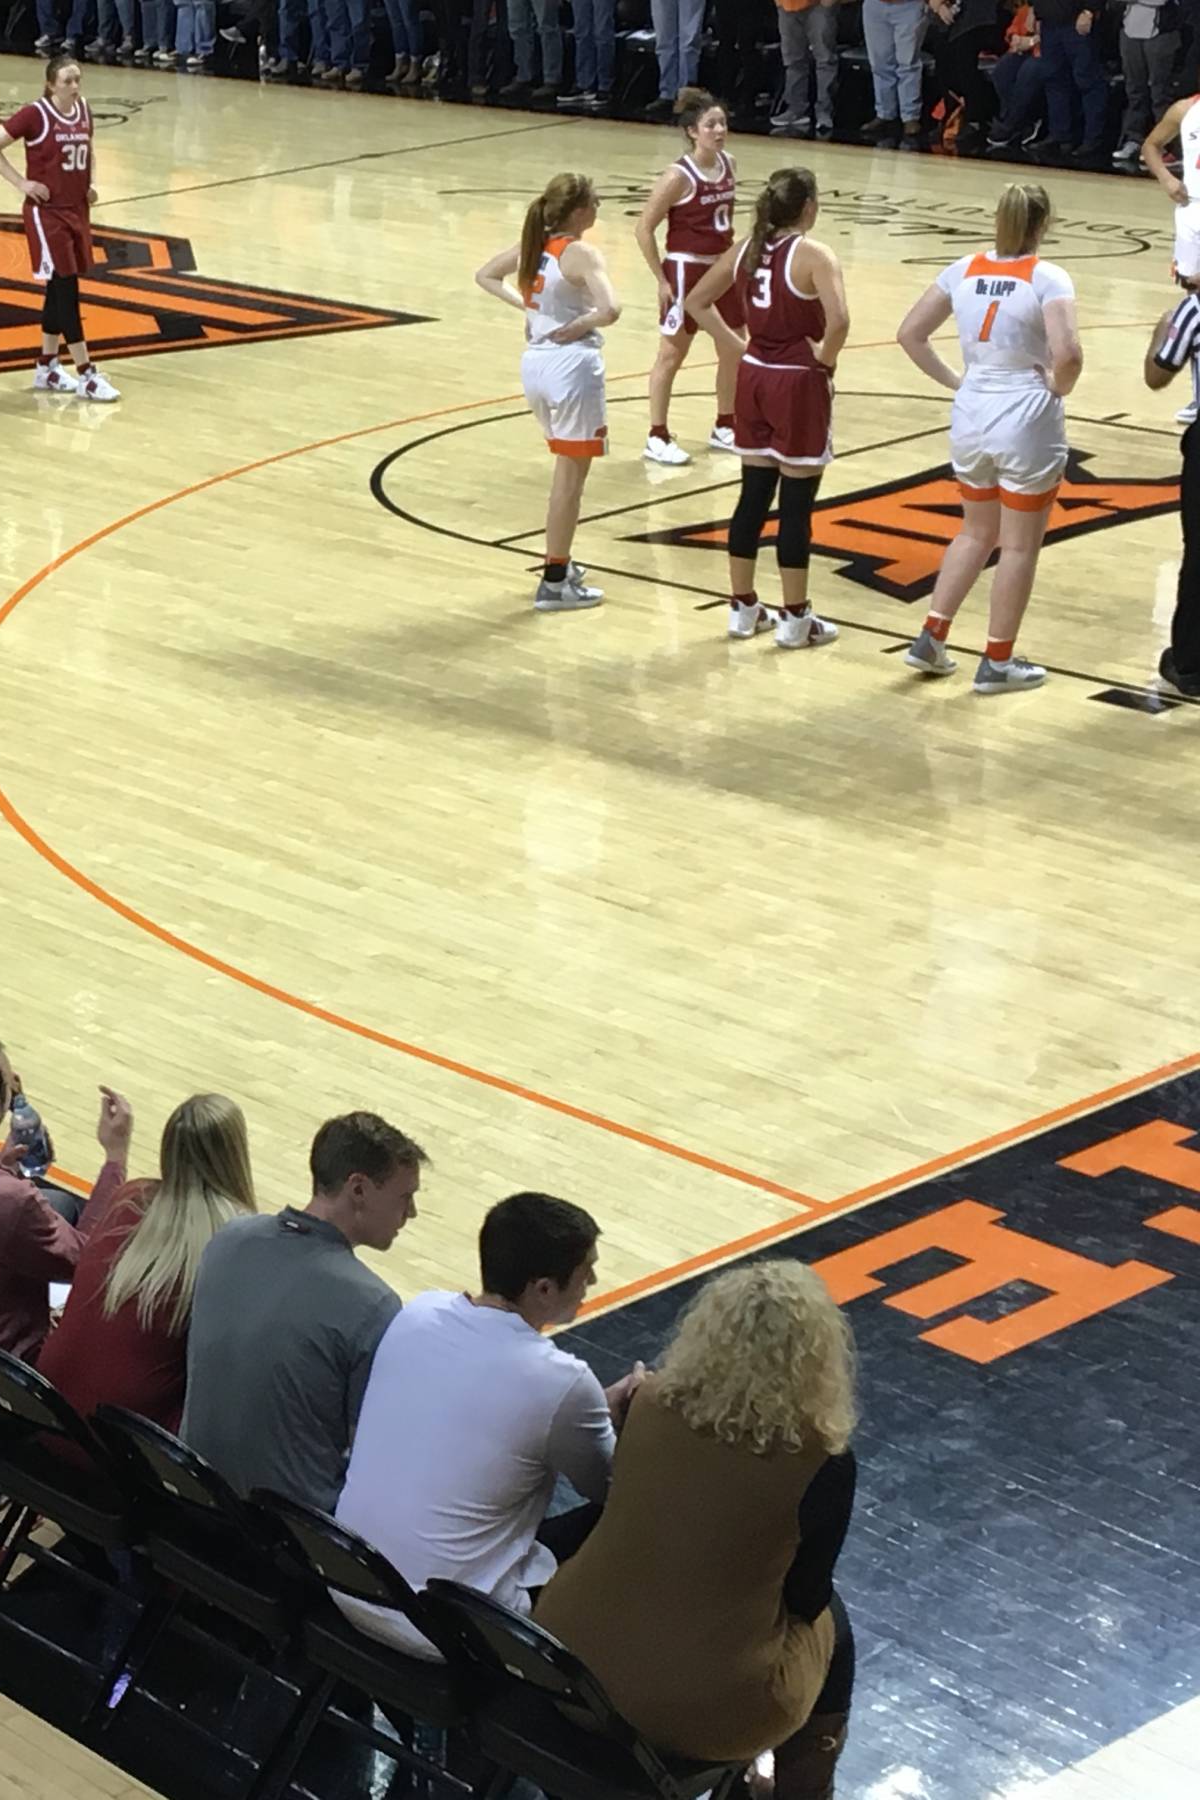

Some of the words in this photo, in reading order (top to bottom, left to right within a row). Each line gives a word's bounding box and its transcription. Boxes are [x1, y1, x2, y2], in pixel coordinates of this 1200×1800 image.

[61, 144, 88, 171] 30
[713, 204, 730, 232] 0
[816, 187, 997, 219] UTTON
[752, 267, 772, 309] 3
[978, 300, 1000, 342] 1
